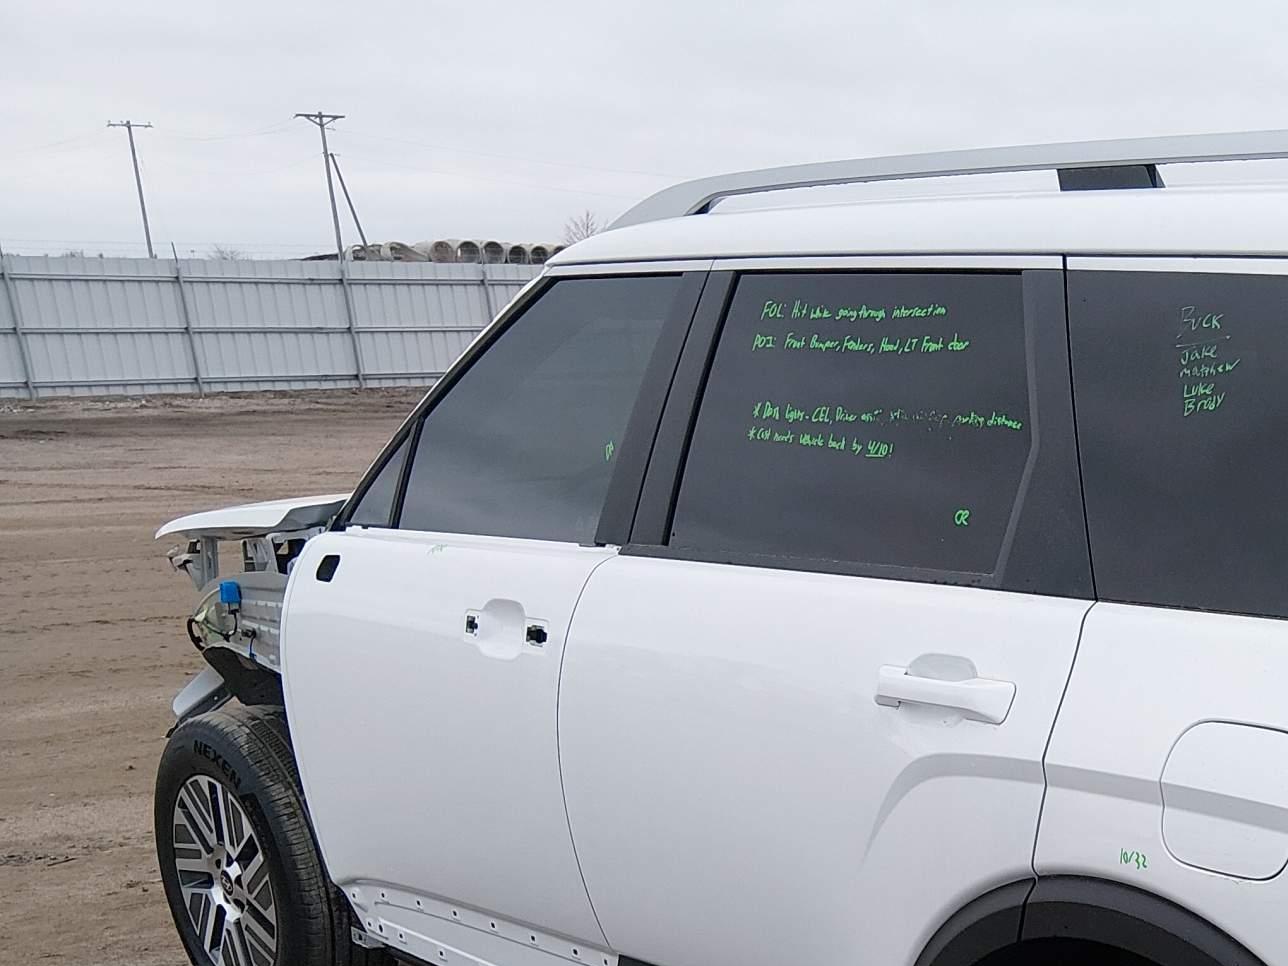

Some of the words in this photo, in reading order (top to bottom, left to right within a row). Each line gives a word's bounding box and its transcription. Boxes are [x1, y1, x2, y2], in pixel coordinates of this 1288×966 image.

[792, 300, 807, 318] Hit
[892, 304, 946, 319] intersection
[785, 333, 805, 349] Front
[921, 336, 944, 352] Front
[948, 333, 970, 350] door
[194, 740, 240, 790] NEXEN
